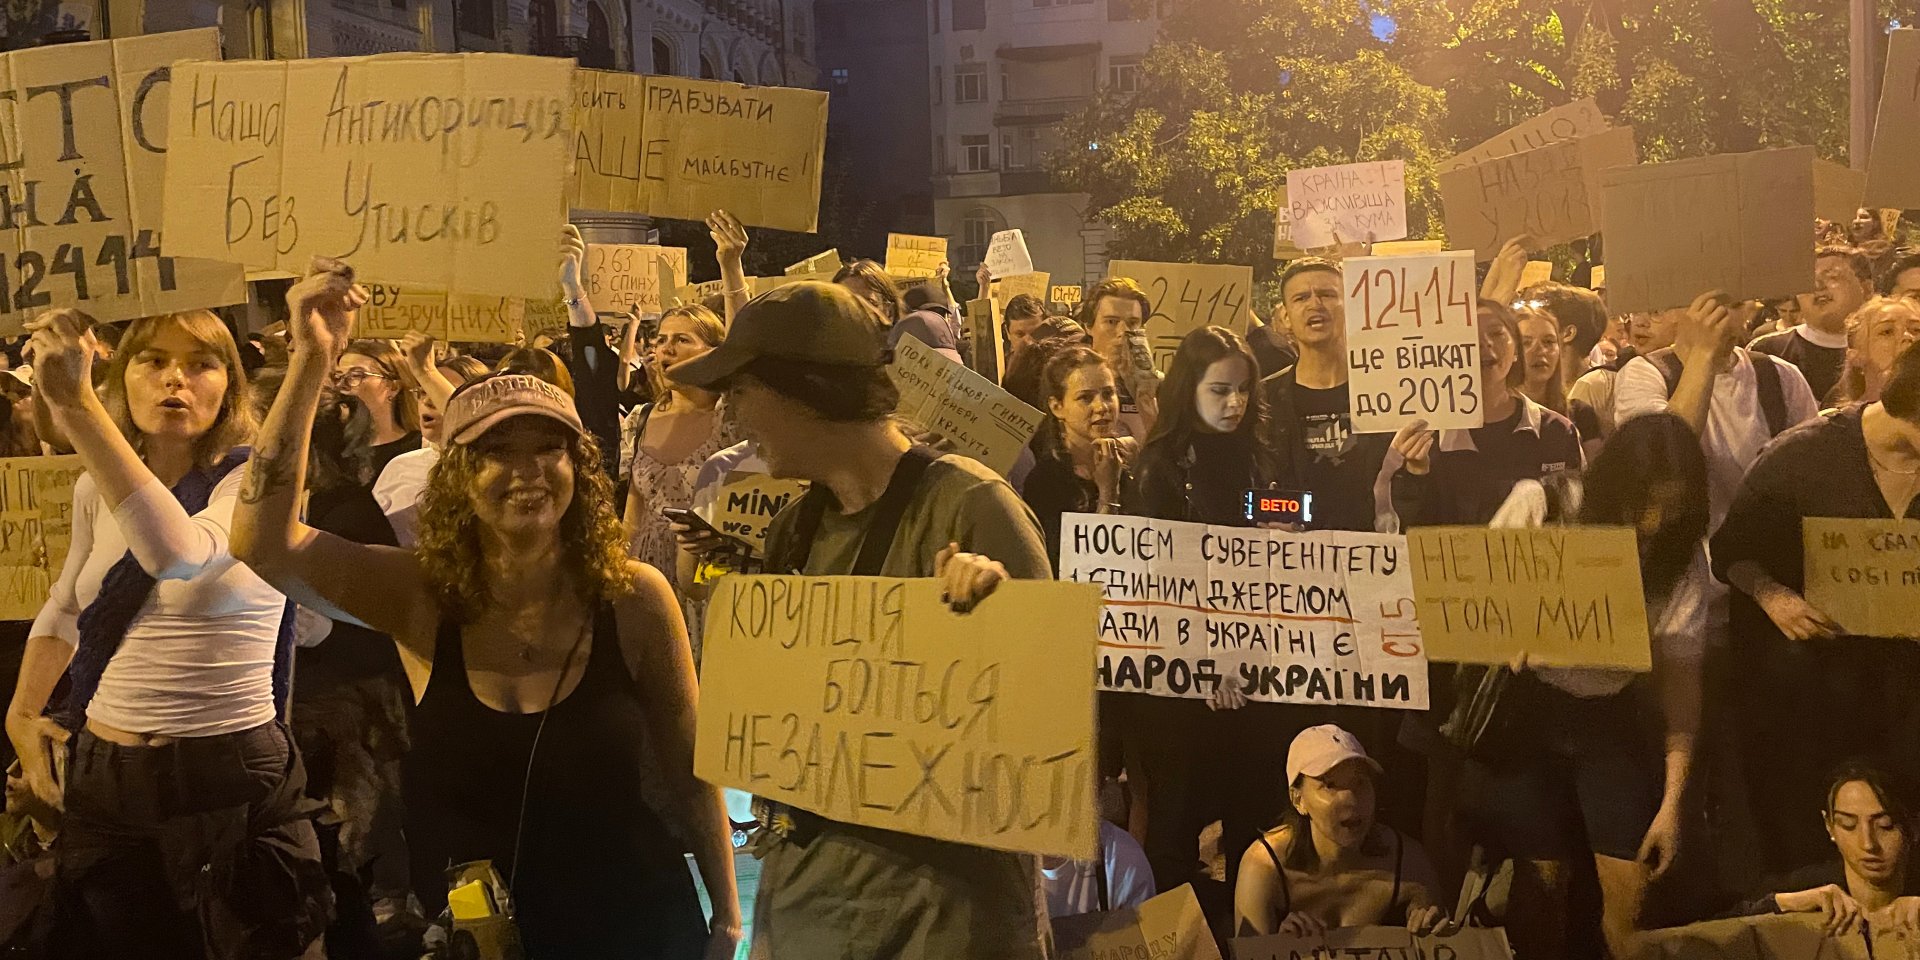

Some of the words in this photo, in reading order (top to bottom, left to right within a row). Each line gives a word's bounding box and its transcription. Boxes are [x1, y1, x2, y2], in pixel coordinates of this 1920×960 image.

[191, 72, 280, 146] Наша
[321, 64, 572, 168] Антикорупція
[573, 90, 626, 110] СИТЬ
[649, 86, 773, 124] ГРАБУВАТИ
[574, 131, 669, 181] АШЕ
[683, 155, 790, 182] МАЙБУТНЄ
[225, 155, 298, 255] Без
[343, 160, 500, 258] Утисків
[597, 248, 631, 273] 263
[610, 275, 656, 292] СПИНУ
[1151, 276, 1245, 325] 2414
[1350, 260, 1473, 331] 12414
[900, 345, 932, 369] ПОКИ
[991, 402, 1034, 434] ГИНУТЬ
[1399, 374, 1478, 416] 2013
[938, 416, 990, 456] КРАДУТЬ
[1260, 498, 1300, 513] ВЕТО
[755, 526, 769, 539] s
[1073, 523, 1174, 561] НОСІЄМ
[1201, 533, 1398, 576] СУВЕРЕНІТЕТУ
[1418, 534, 1475, 584] НЕ
[1483, 533, 1566, 586] НАБУ
[730, 578, 905, 657] КОРУПЦІЯ
[1206, 579, 1353, 617] ДЖЕРЕЛОМ
[1424, 595, 1513, 638] ТОДІ
[1098, 611, 1161, 643] АДИ
[1178, 617, 1191, 646] В
[1205, 619, 1315, 658] УКРАЇНІ
[1334, 632, 1354, 656] Є
[1238, 660, 1411, 702] УКРАЇНИ
